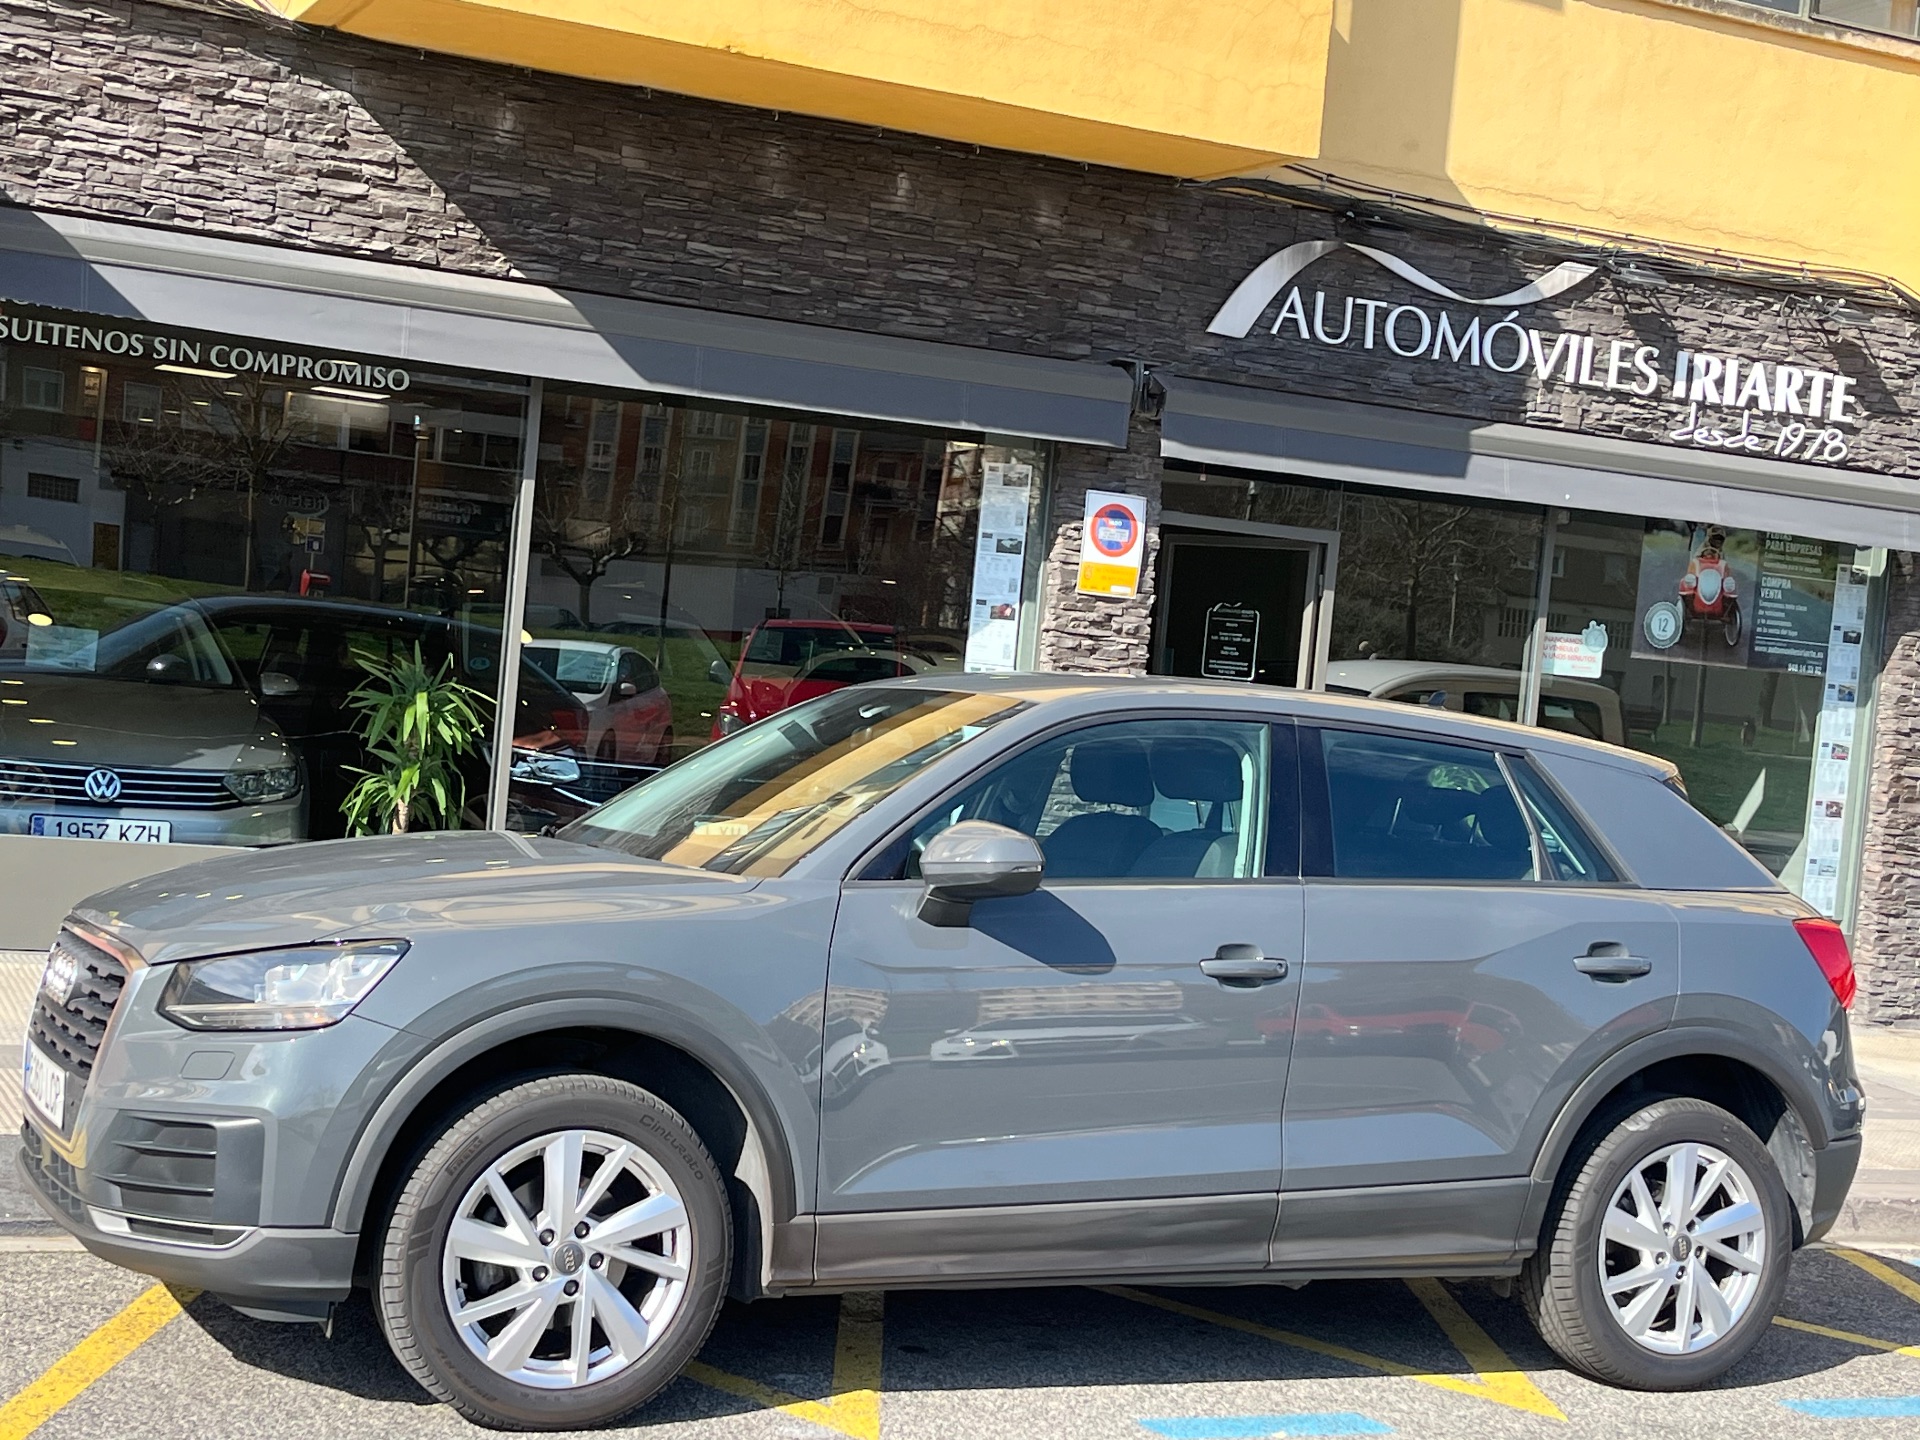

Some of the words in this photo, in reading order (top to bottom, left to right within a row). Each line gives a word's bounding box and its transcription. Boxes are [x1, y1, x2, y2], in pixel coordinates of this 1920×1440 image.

[1270, 286, 1660, 396] AUTOMÓVILES
[1673, 351, 1857, 423] IRIARTE
[152, 336, 201, 364] SIN
[210, 345, 410, 391] COMPROMISO
[1669, 402, 1764, 454] desde
[1774, 423, 1848, 463] 1978
[1765, 540, 1785, 552] PARA
[1785, 542, 1823, 556] EMPRESAS
[1761, 576, 1792, 590] COMPRA
[1760, 587, 1782, 600] VENTA
[1658, 617, 1669, 632] 12
